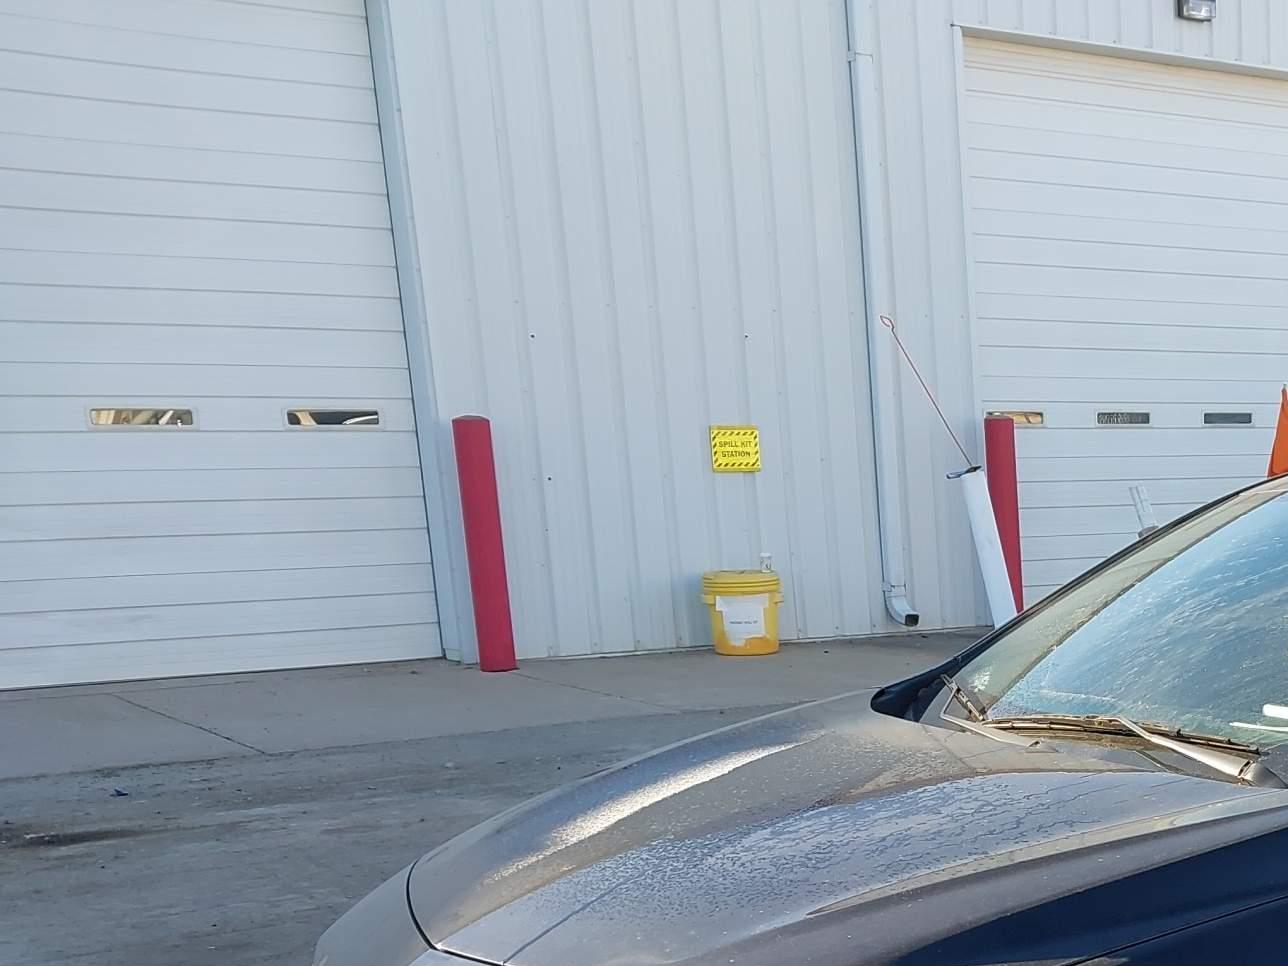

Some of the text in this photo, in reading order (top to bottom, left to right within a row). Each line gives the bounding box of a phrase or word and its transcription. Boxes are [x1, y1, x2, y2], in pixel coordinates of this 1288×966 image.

[718, 440, 752, 448] SPILL KIT
[721, 450, 750, 458] STATION
